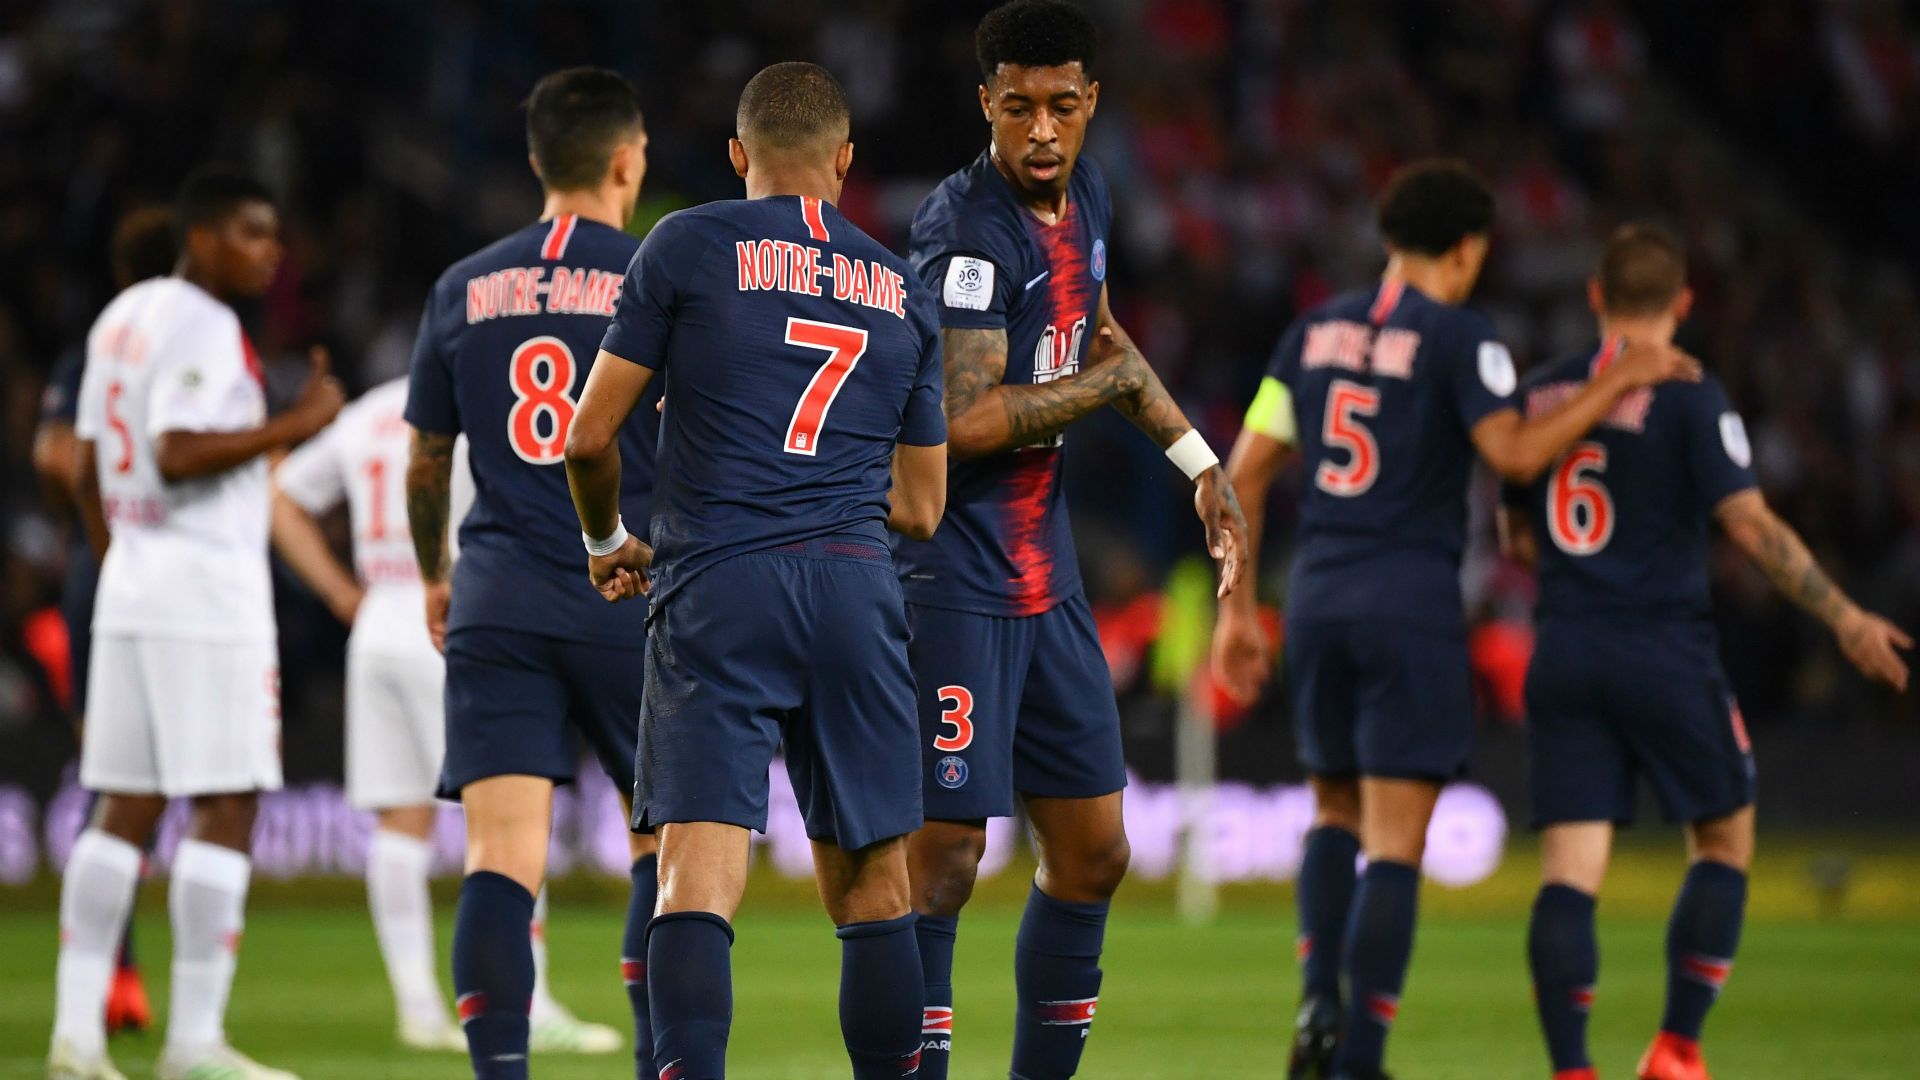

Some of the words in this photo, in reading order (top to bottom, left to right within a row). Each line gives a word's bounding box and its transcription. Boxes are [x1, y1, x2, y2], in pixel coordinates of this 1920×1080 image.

[467, 266, 624, 325] NOTRE-DAME
[736, 239, 907, 319] NOTRE-DAME
[105, 380, 134, 475] 5
[507, 335, 577, 465] 8
[784, 316, 869, 457] 7
[1314, 378, 1382, 498] 5
[1546, 439, 1616, 557] 6
[933, 685, 974, 752] 3
